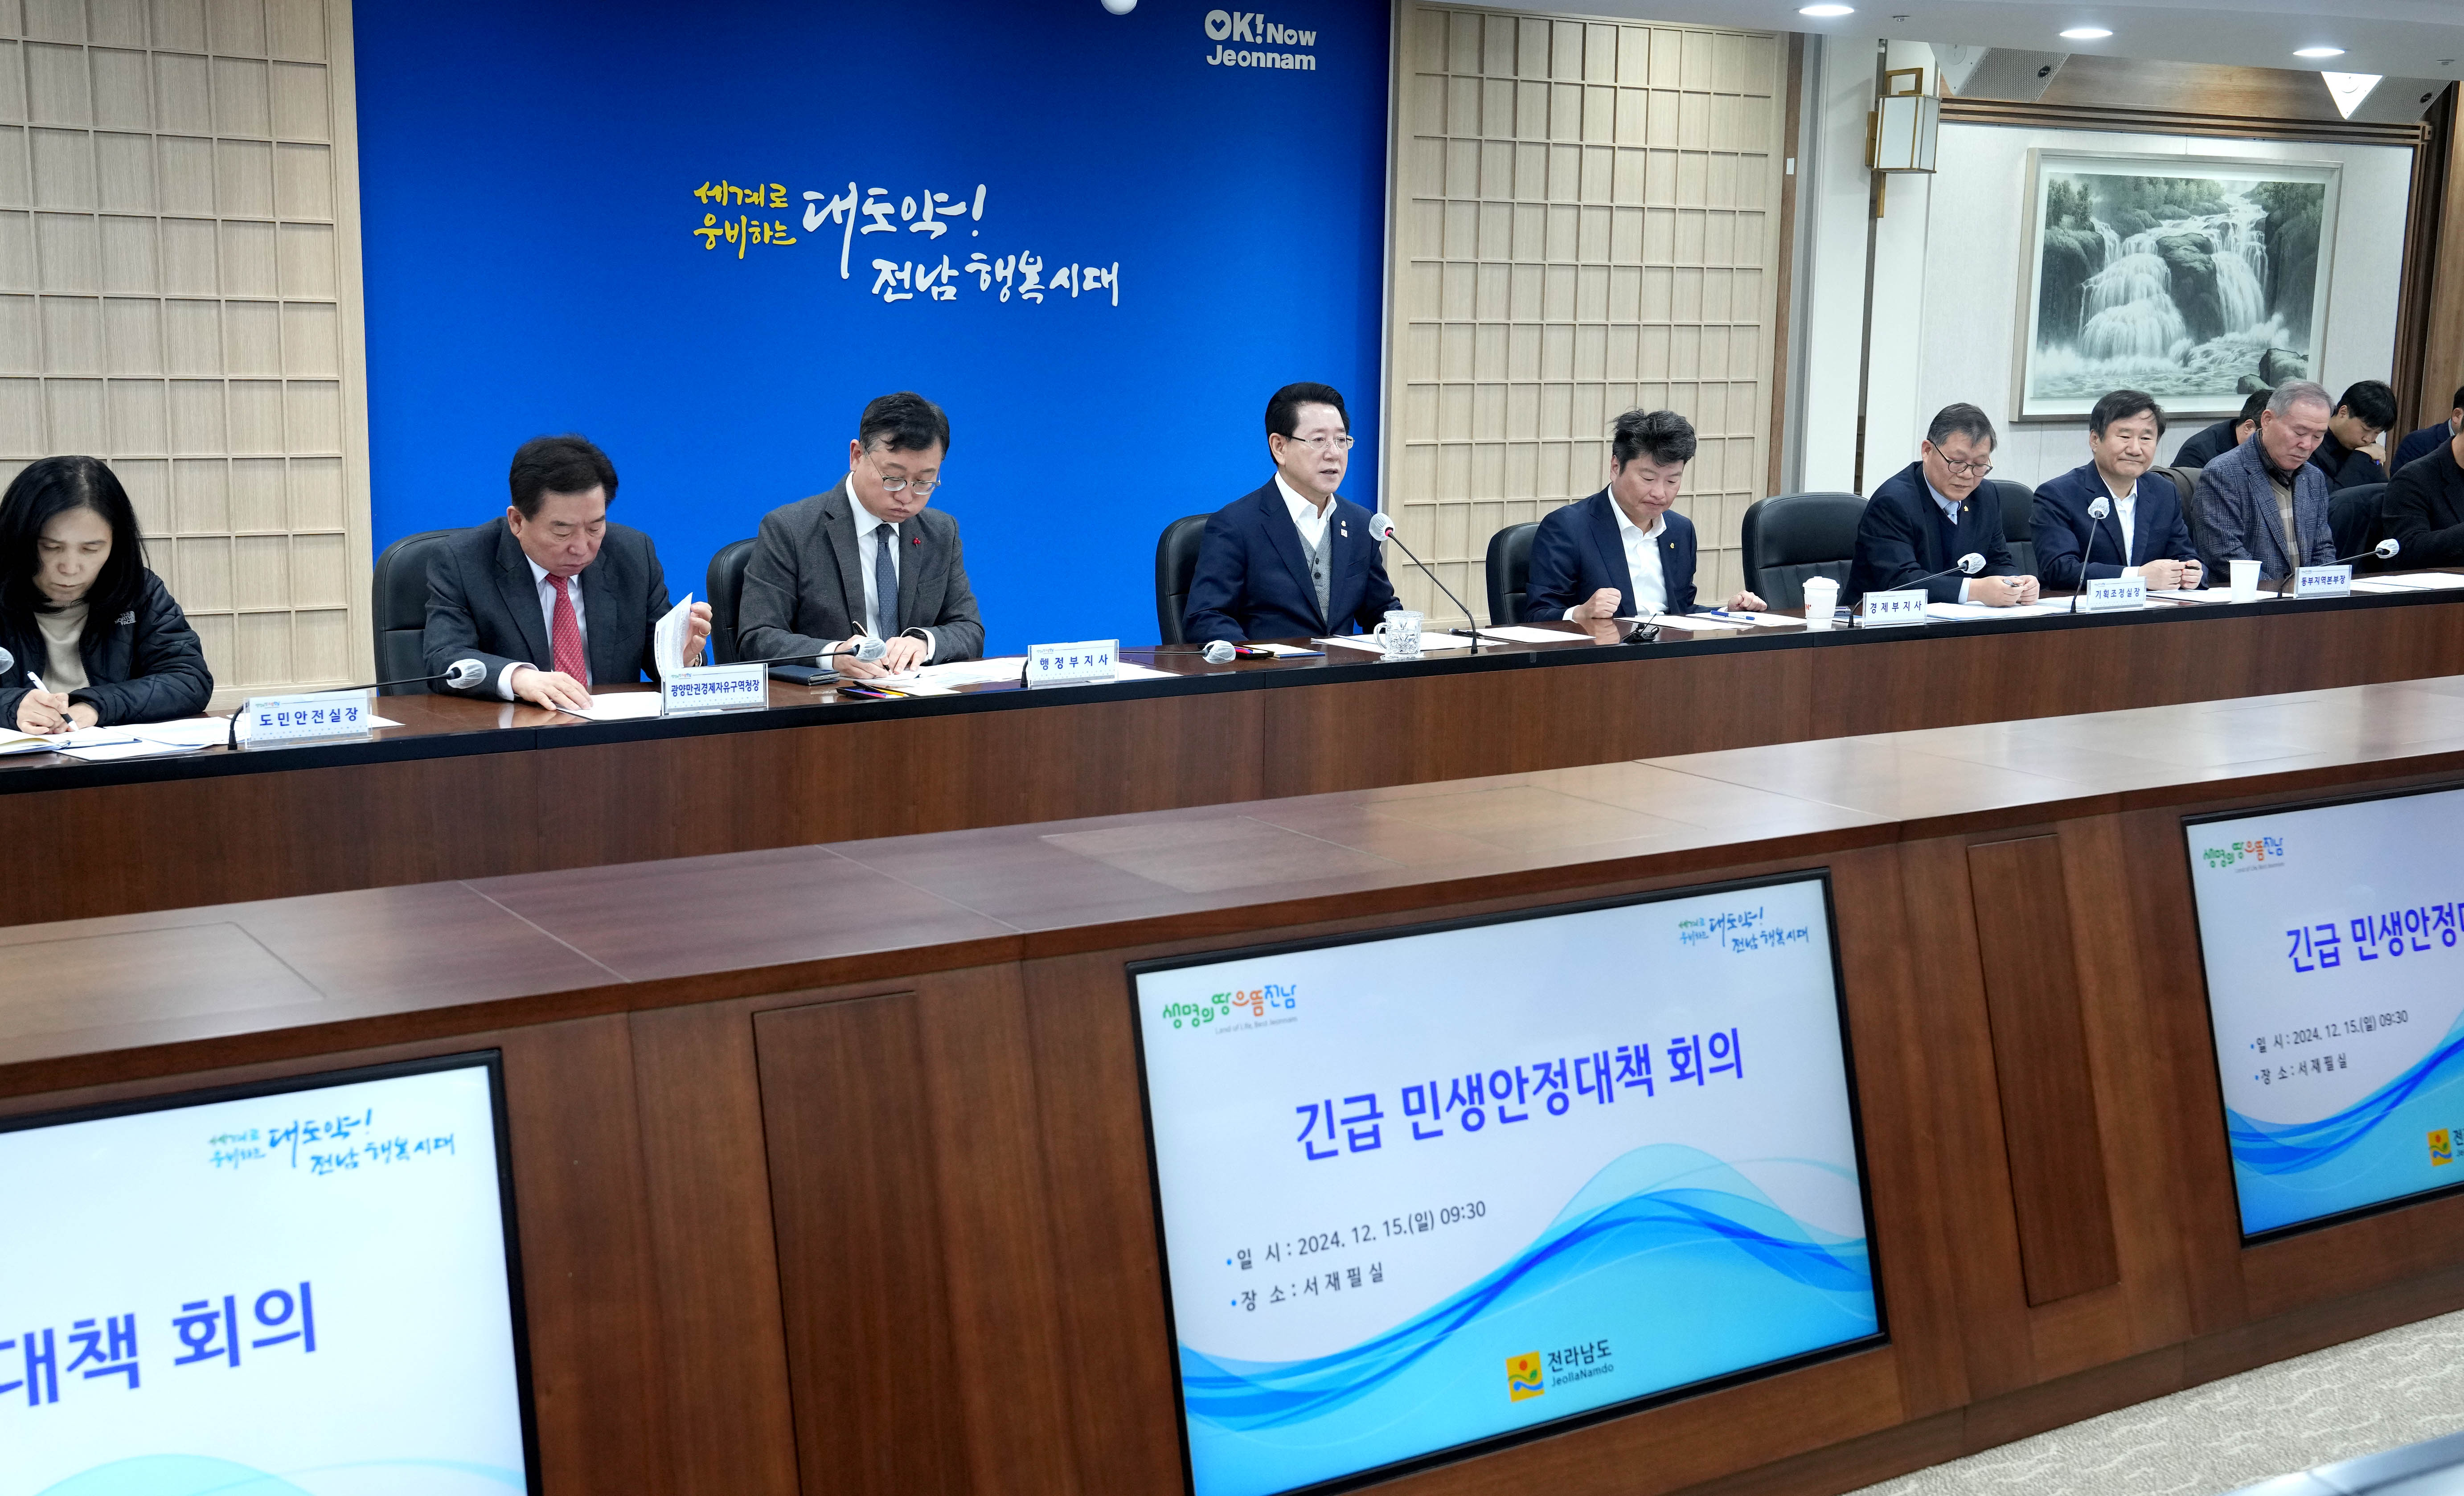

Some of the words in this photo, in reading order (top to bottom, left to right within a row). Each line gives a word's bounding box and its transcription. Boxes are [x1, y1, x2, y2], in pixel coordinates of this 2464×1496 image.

[1205, 9, 1264, 44] OK!
[1267, 23, 1316, 46] Now
[1206, 45, 1316, 70] Jeonnam
[693, 180, 789, 209] 세계로
[693, 213, 797, 259] 웅비하는
[803, 181, 986, 279] 대도약!
[872, 254, 957, 303] 전남
[2095, 587, 2140, 599] 기획조정실장
[2301, 575, 2345, 586] 동부지역본부장
[115, 616, 131, 624] NORTH
[671, 679, 760, 697] 광양만권경제자유구역청장
[1709, 906, 1763, 947] 대도약!
[1732, 934, 1759, 953] 전남
[2287, 923, 2341, 973] 긴급
[1163, 1003, 1214, 1029] 생명의
[1212, 992, 1232, 1016] 땅
[2379, 1010, 2408, 1027] 09:30
[1296, 1093, 1385, 1161] 긴급
[1401, 1042, 1655, 1140] 민생안정대책
[1666, 1027, 1744, 1086] 회의
[268, 1108, 373, 1168] 대도약!
[310, 1147, 359, 1176] 전남
[1440, 1200, 1486, 1225] 09:30
[172, 1280, 317, 1369] 회의
[1547, 1339, 1612, 1373] 전라남도
[1551, 1361, 1614, 1387] JeollaNamdo
